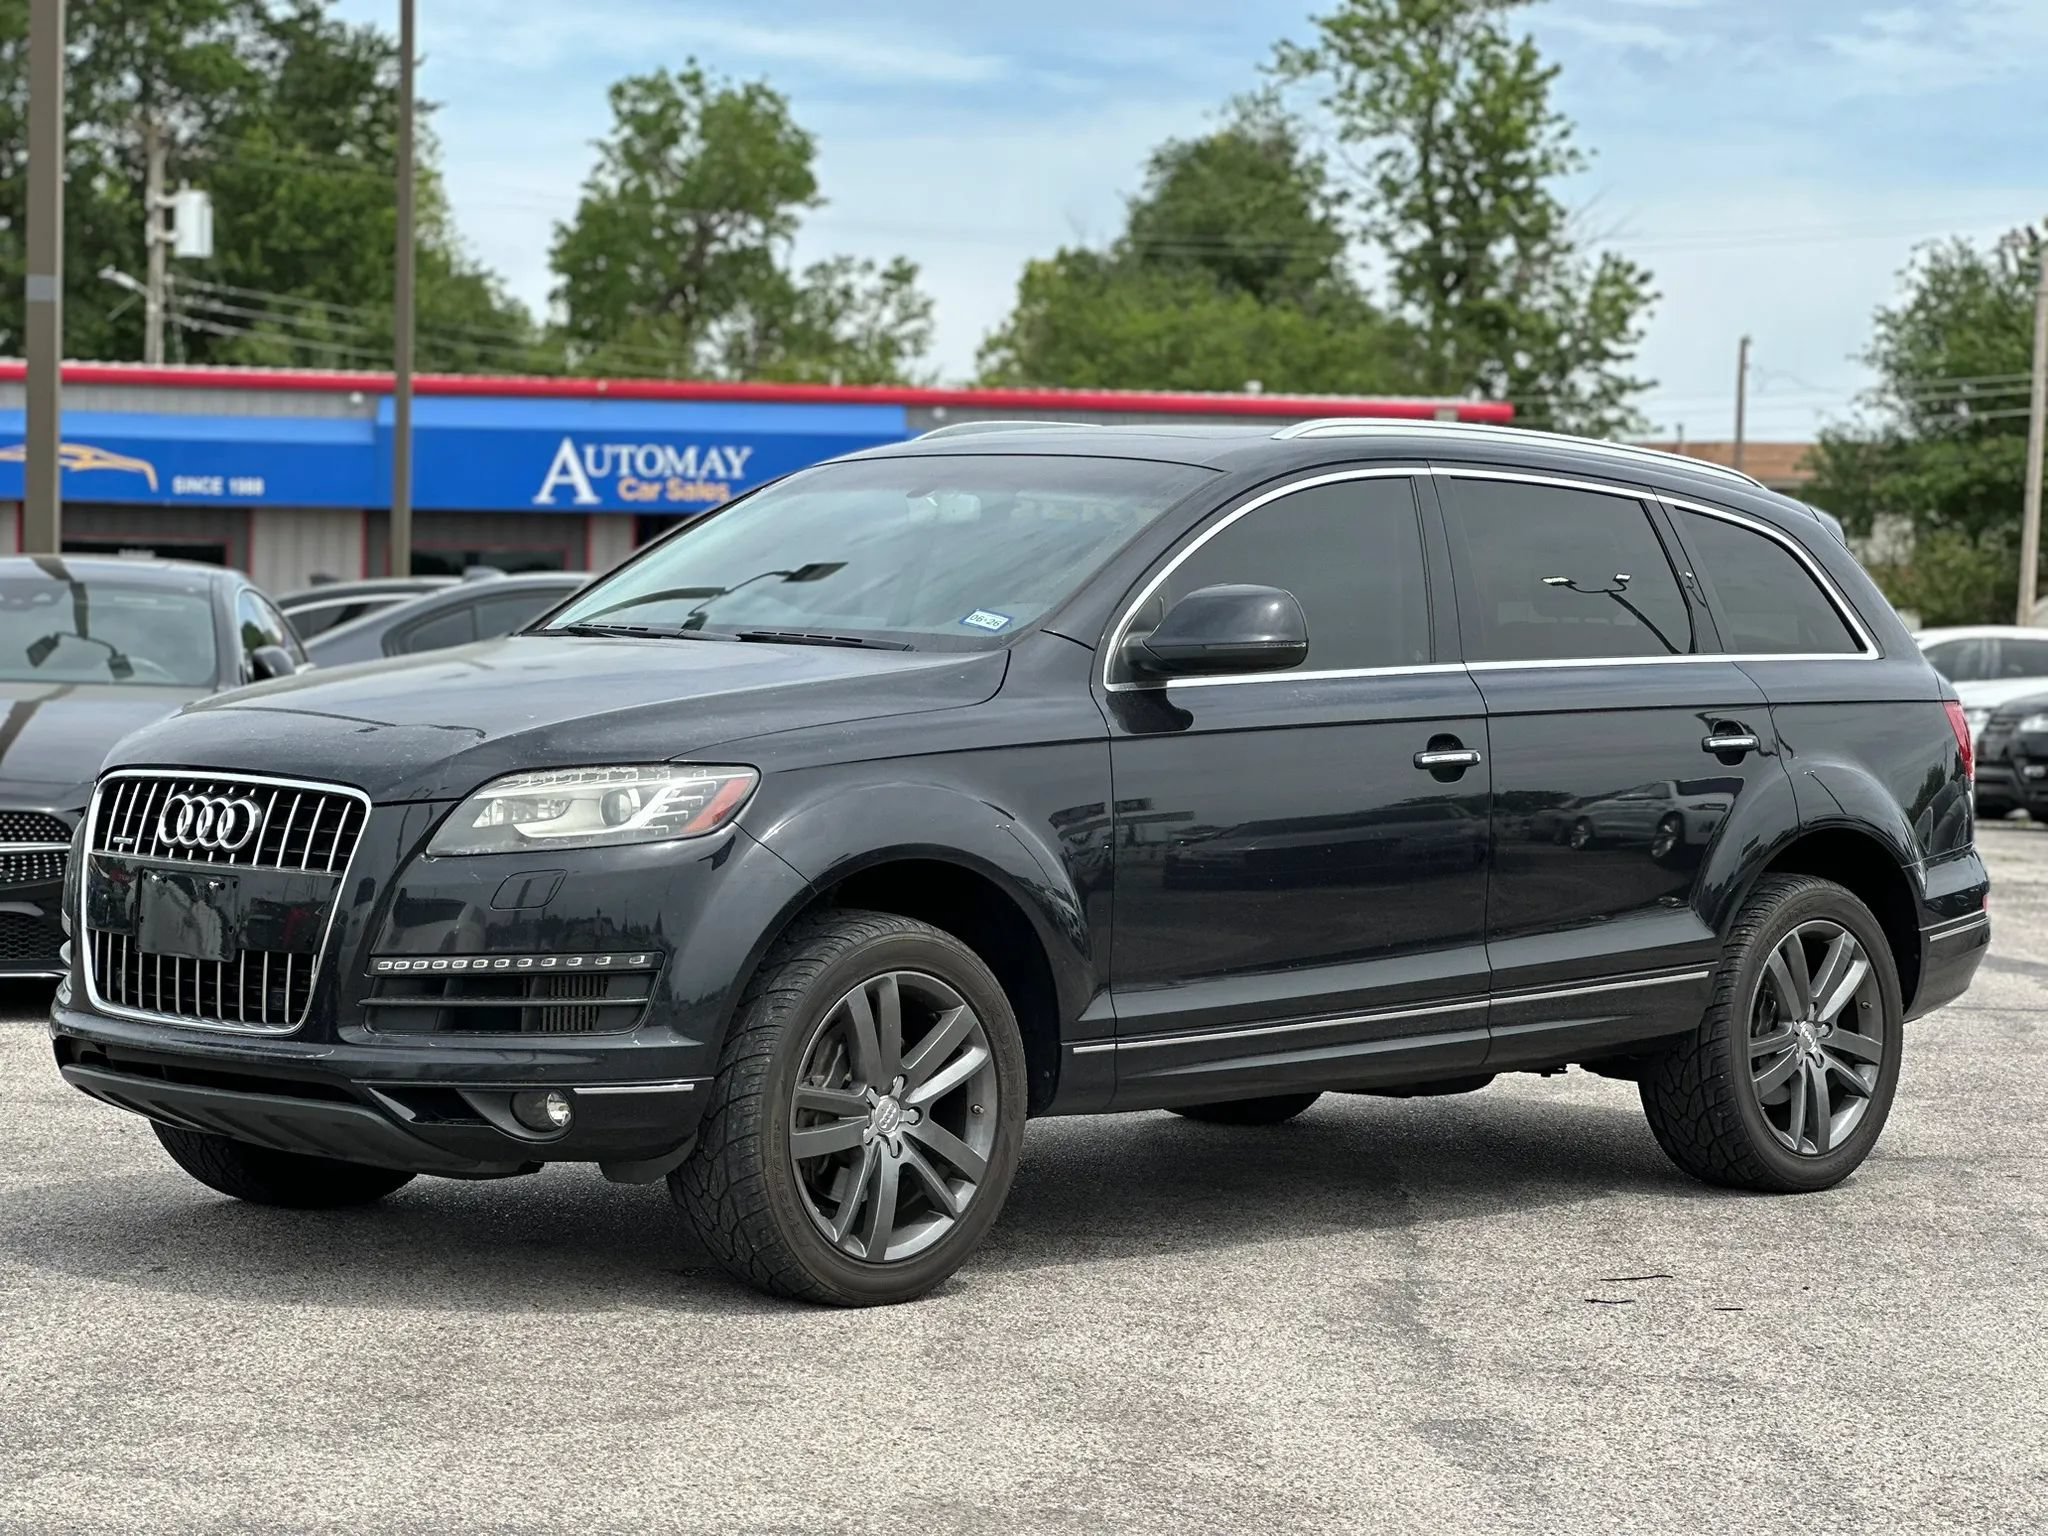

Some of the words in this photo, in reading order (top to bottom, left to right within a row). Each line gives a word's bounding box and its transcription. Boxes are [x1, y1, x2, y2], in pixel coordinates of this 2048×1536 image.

[533, 437, 752, 503] AUTOMAY
[172, 476, 222, 495] SINCE
[618, 477, 662, 502] Car
[666, 478, 731, 503] Sales
